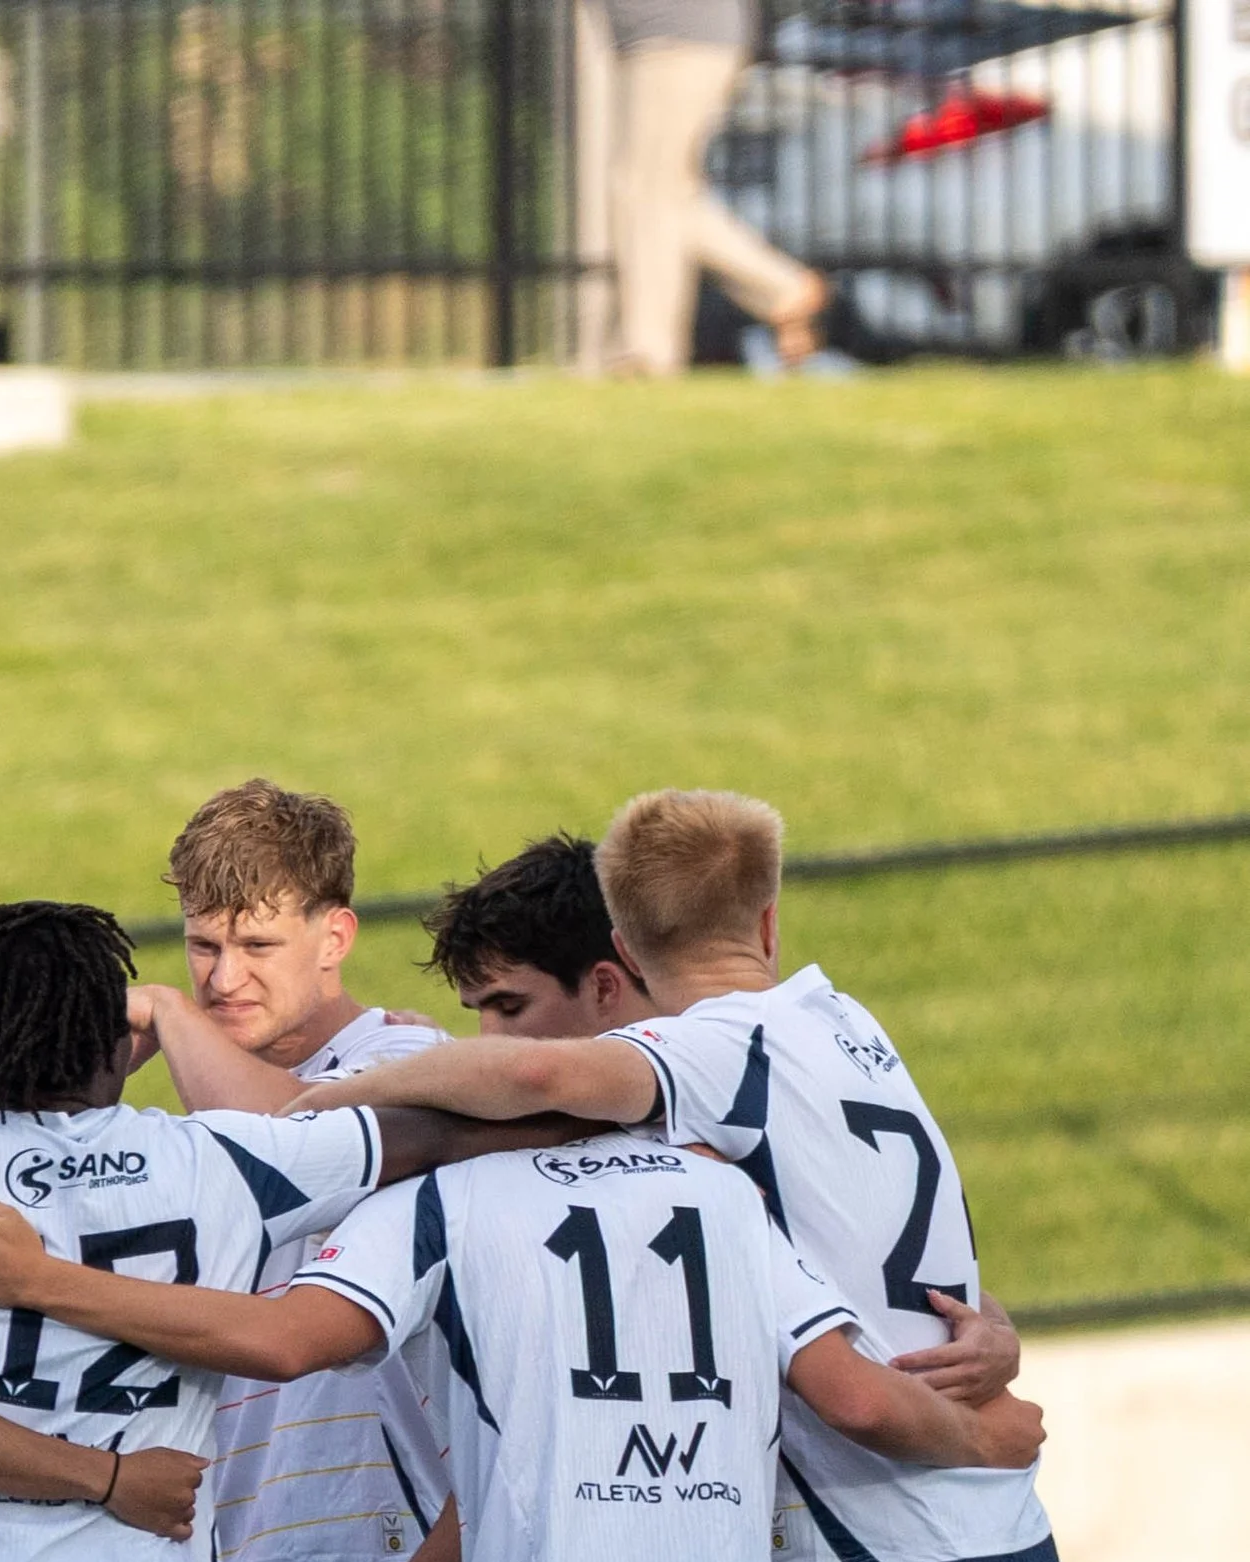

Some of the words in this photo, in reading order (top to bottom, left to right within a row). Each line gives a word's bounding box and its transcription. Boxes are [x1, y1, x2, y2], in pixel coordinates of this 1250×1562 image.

[58, 1151, 146, 1180] SANO
[578, 1154, 682, 1175] SANO
[622, 1166, 687, 1175] ORTHOPEDICS
[543, 1204, 732, 1410] 11
[575, 1482, 662, 1504] ATLETAS
[675, 1482, 741, 1506] WORLD
